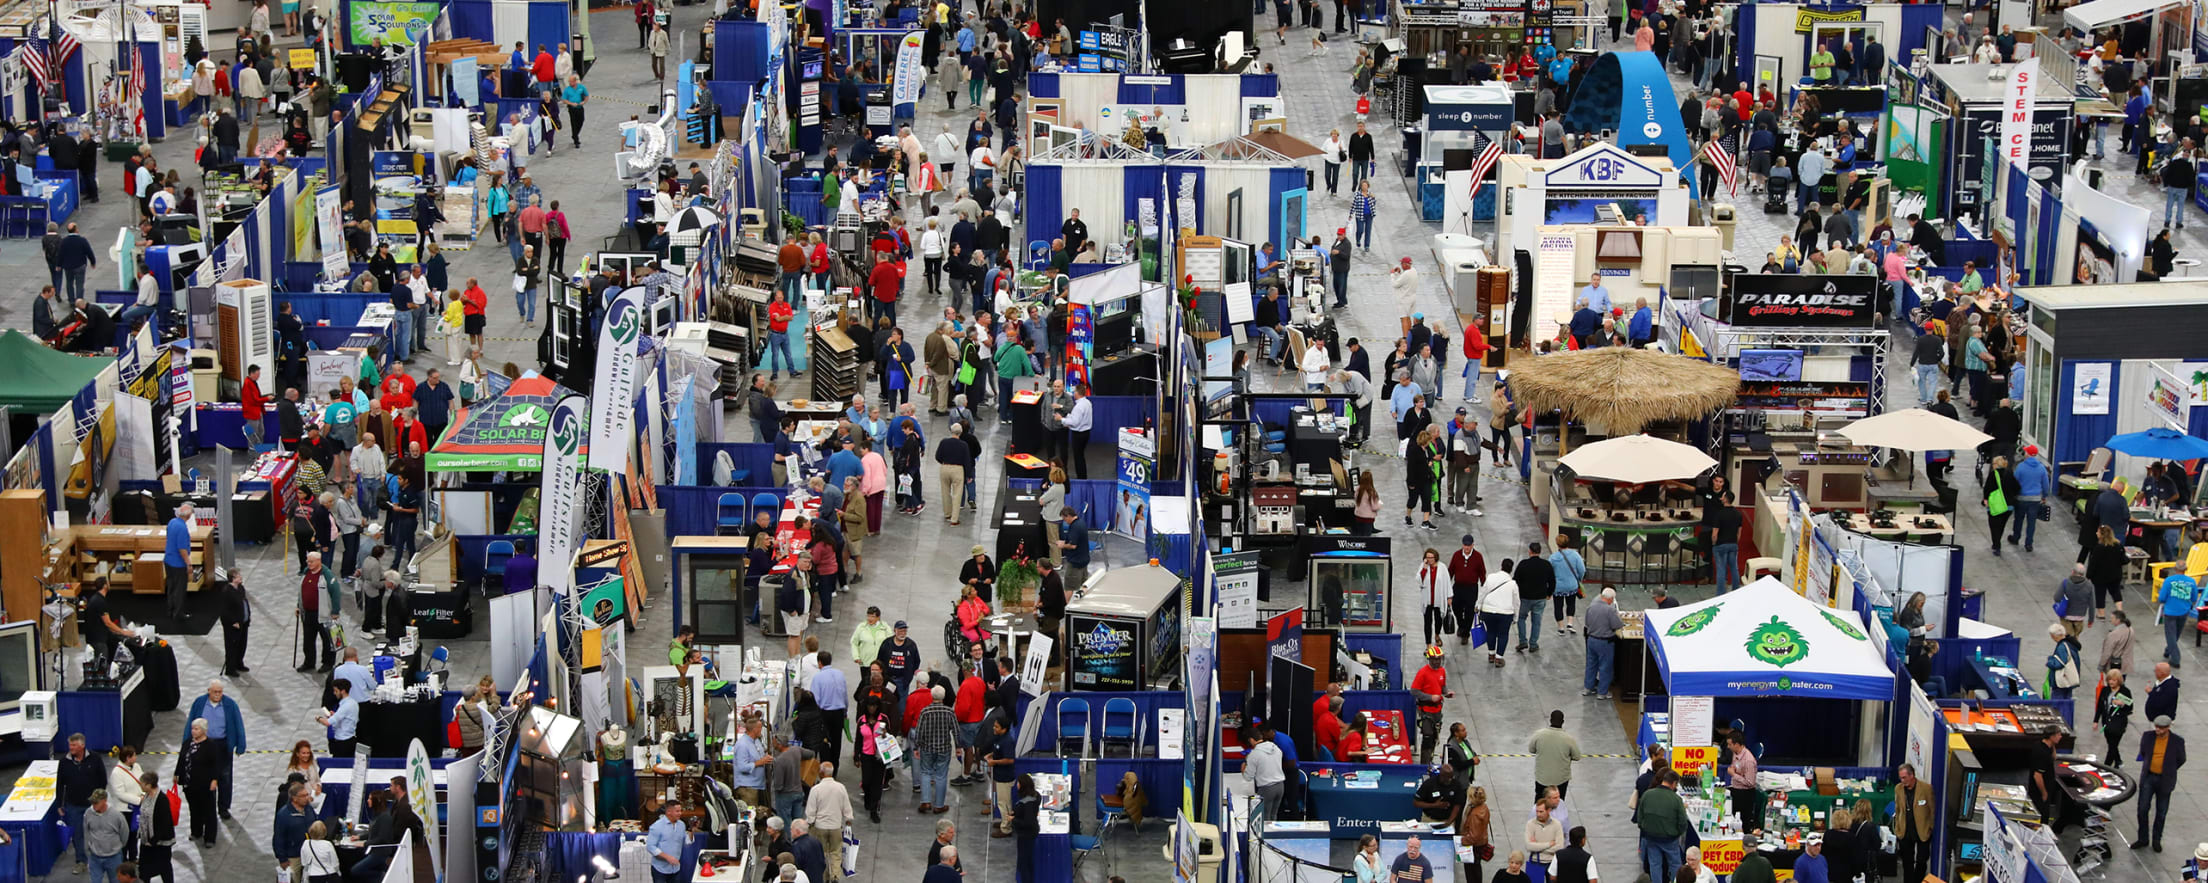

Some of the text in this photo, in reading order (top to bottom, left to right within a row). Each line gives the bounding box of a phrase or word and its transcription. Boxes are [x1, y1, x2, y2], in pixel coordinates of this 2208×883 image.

[368, 14, 395, 25] SOLAR
[378, 22, 421, 33] SOLUTIONS
[1101, 32, 1122, 47] EAGLE
[896, 50, 909, 100] CAREFREE
[1642, 84, 1655, 120] number
[2012, 72, 2028, 122] STEM
[1438, 112, 1459, 120] sleep
[1580, 158, 1625, 180] KBF
[1738, 294, 1868, 306] PARADISE
[1749, 304, 1854, 317] Grilling Systems
[616, 352, 634, 431] Gulfside
[479, 428, 527, 440] SOLAR
[437, 459, 509, 467] oursolarbear.com
[559, 465, 574, 548] Gulfside
[603, 547, 619, 558] Show
[1215, 560, 1243, 570] perfect
[436, 608, 454, 616] Filter
[1077, 630, 1133, 645] PREMIER
[1272, 643, 1286, 657] Blue
[1685, 749, 1705, 759] NO
[1336, 816, 1373, 828] Enter
[1703, 851, 1744, 861] PET CBD
